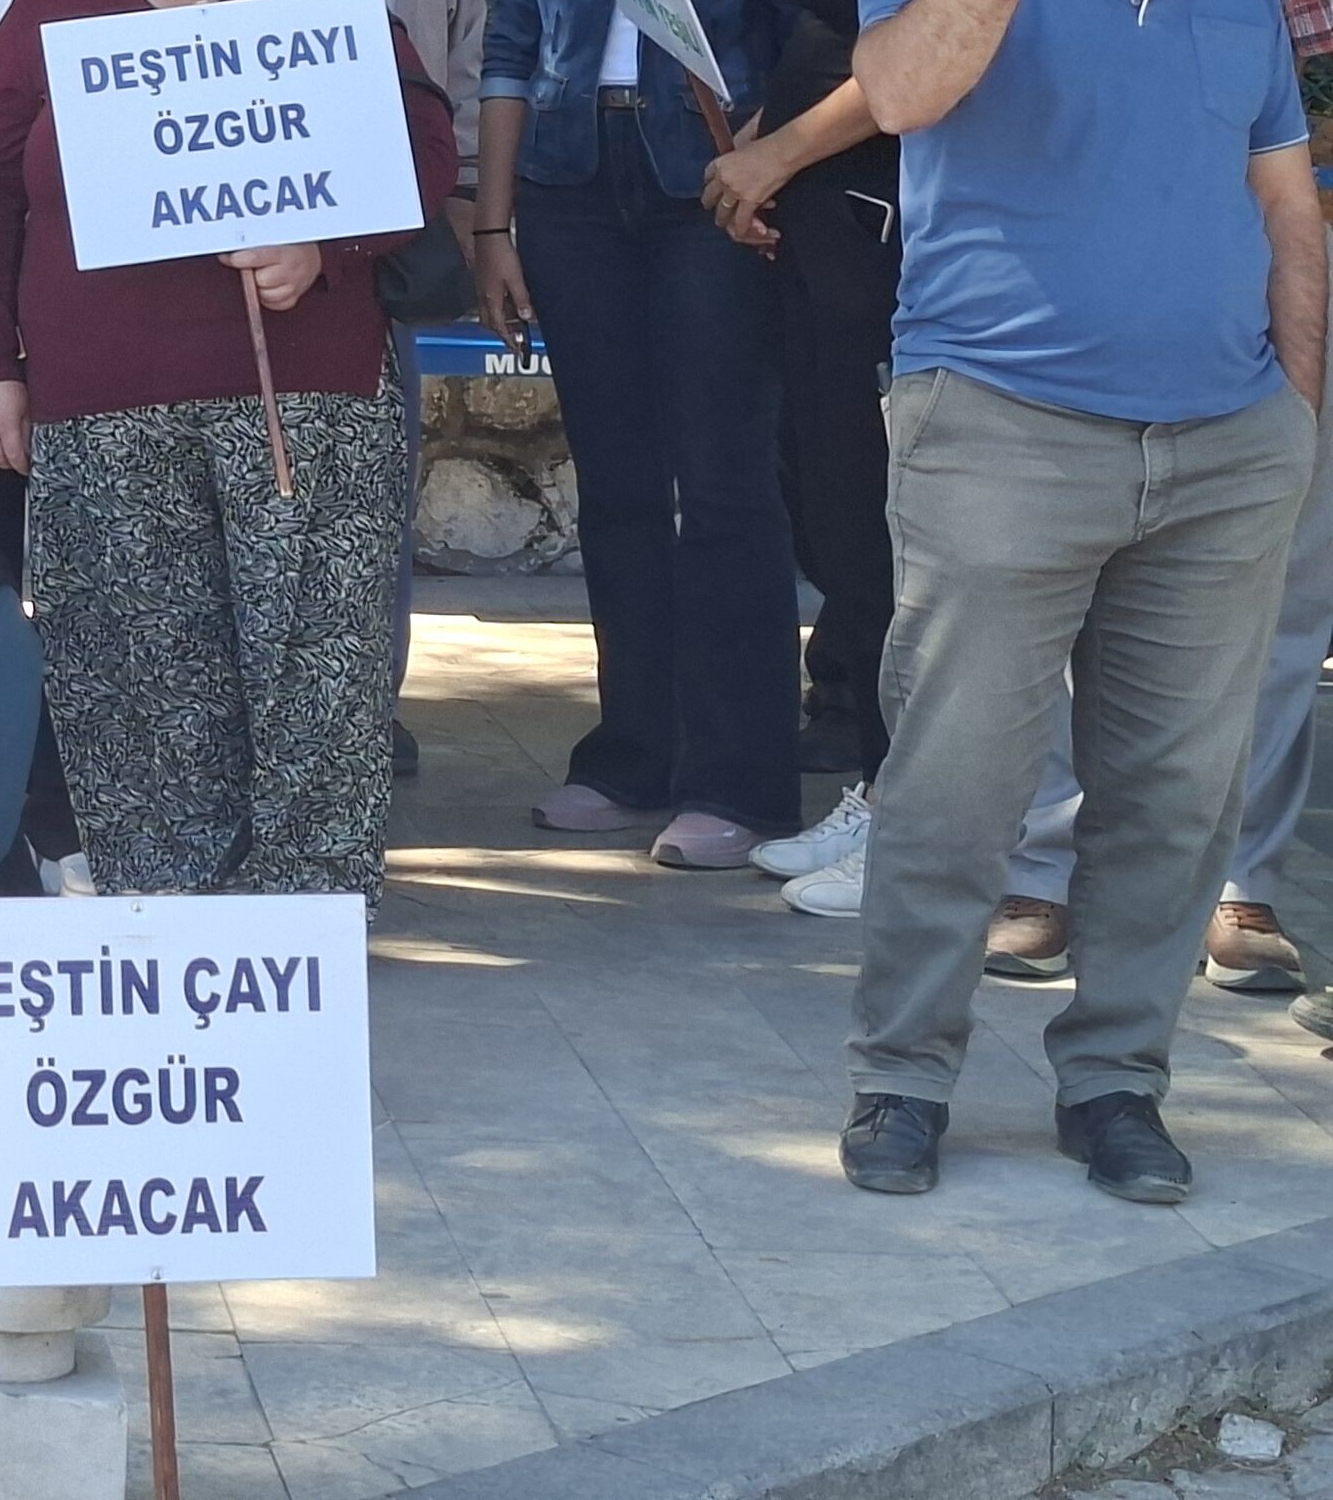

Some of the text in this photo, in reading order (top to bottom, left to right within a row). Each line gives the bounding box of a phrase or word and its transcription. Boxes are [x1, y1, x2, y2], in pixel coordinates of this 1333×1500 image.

[81, 25, 358, 95] DEŞTİN ÇAYI
[154, 98, 310, 155] ÖZGÜR
[151, 170, 338, 228] AKACAK
[183, 956, 321, 1030] ÇAYI
[26, 1055, 244, 1127] ÖZGÜR
[8, 1175, 267, 1238] AKACAK
